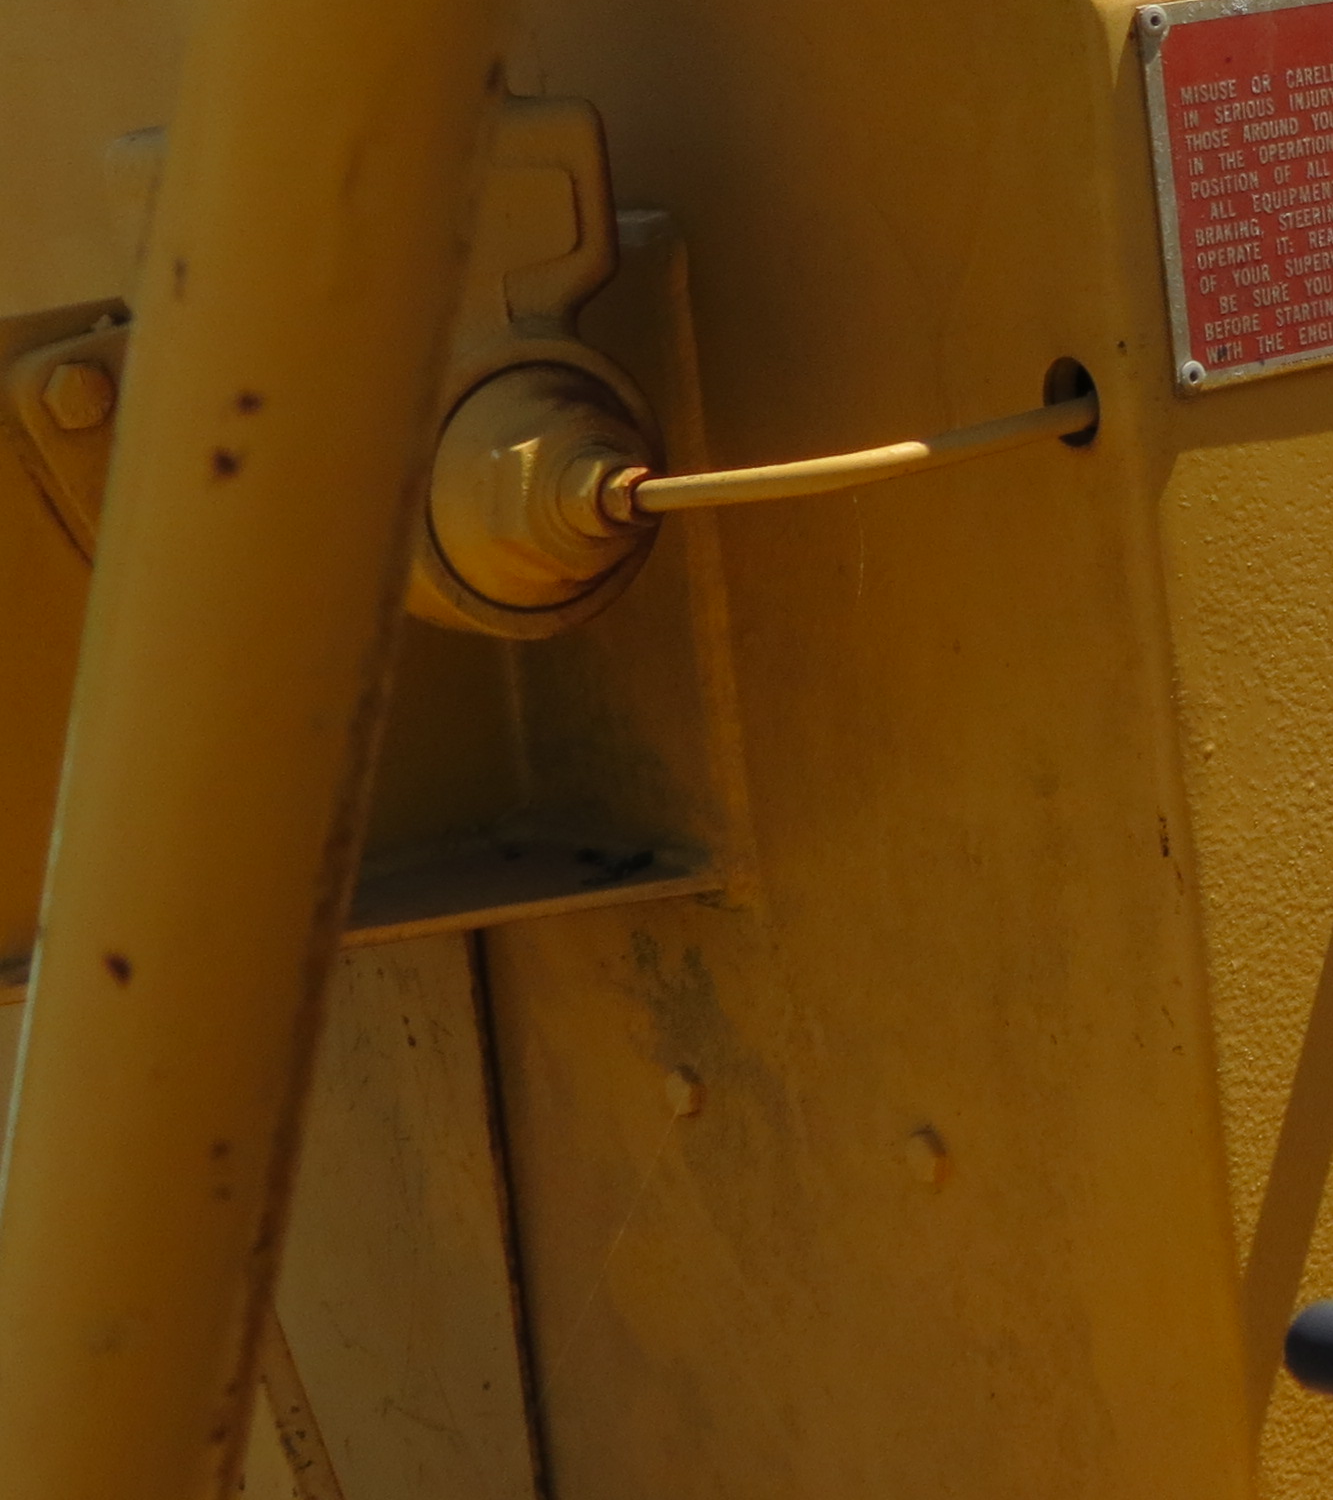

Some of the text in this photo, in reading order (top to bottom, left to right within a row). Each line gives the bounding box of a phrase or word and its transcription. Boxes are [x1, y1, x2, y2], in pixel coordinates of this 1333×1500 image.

[1179, 77, 1237, 105] MISUSE
[1251, 73, 1271, 93] OR
[1183, 109, 1199, 128] IN
[1214, 96, 1274, 124] SERIOUS
[1184, 127, 1230, 152] THOSE
[1242, 116, 1299, 142] AROUND
[1188, 156, 1204, 175] IN
[1218, 149, 1244, 170] THE
[1190, 170, 1259, 200] POSITION
[1273, 164, 1291, 185] OF
[1306, 157, 1330, 178] ALL
[1208, 198, 1236, 220] ALL
[1256, 330, 1290, 354] THE
